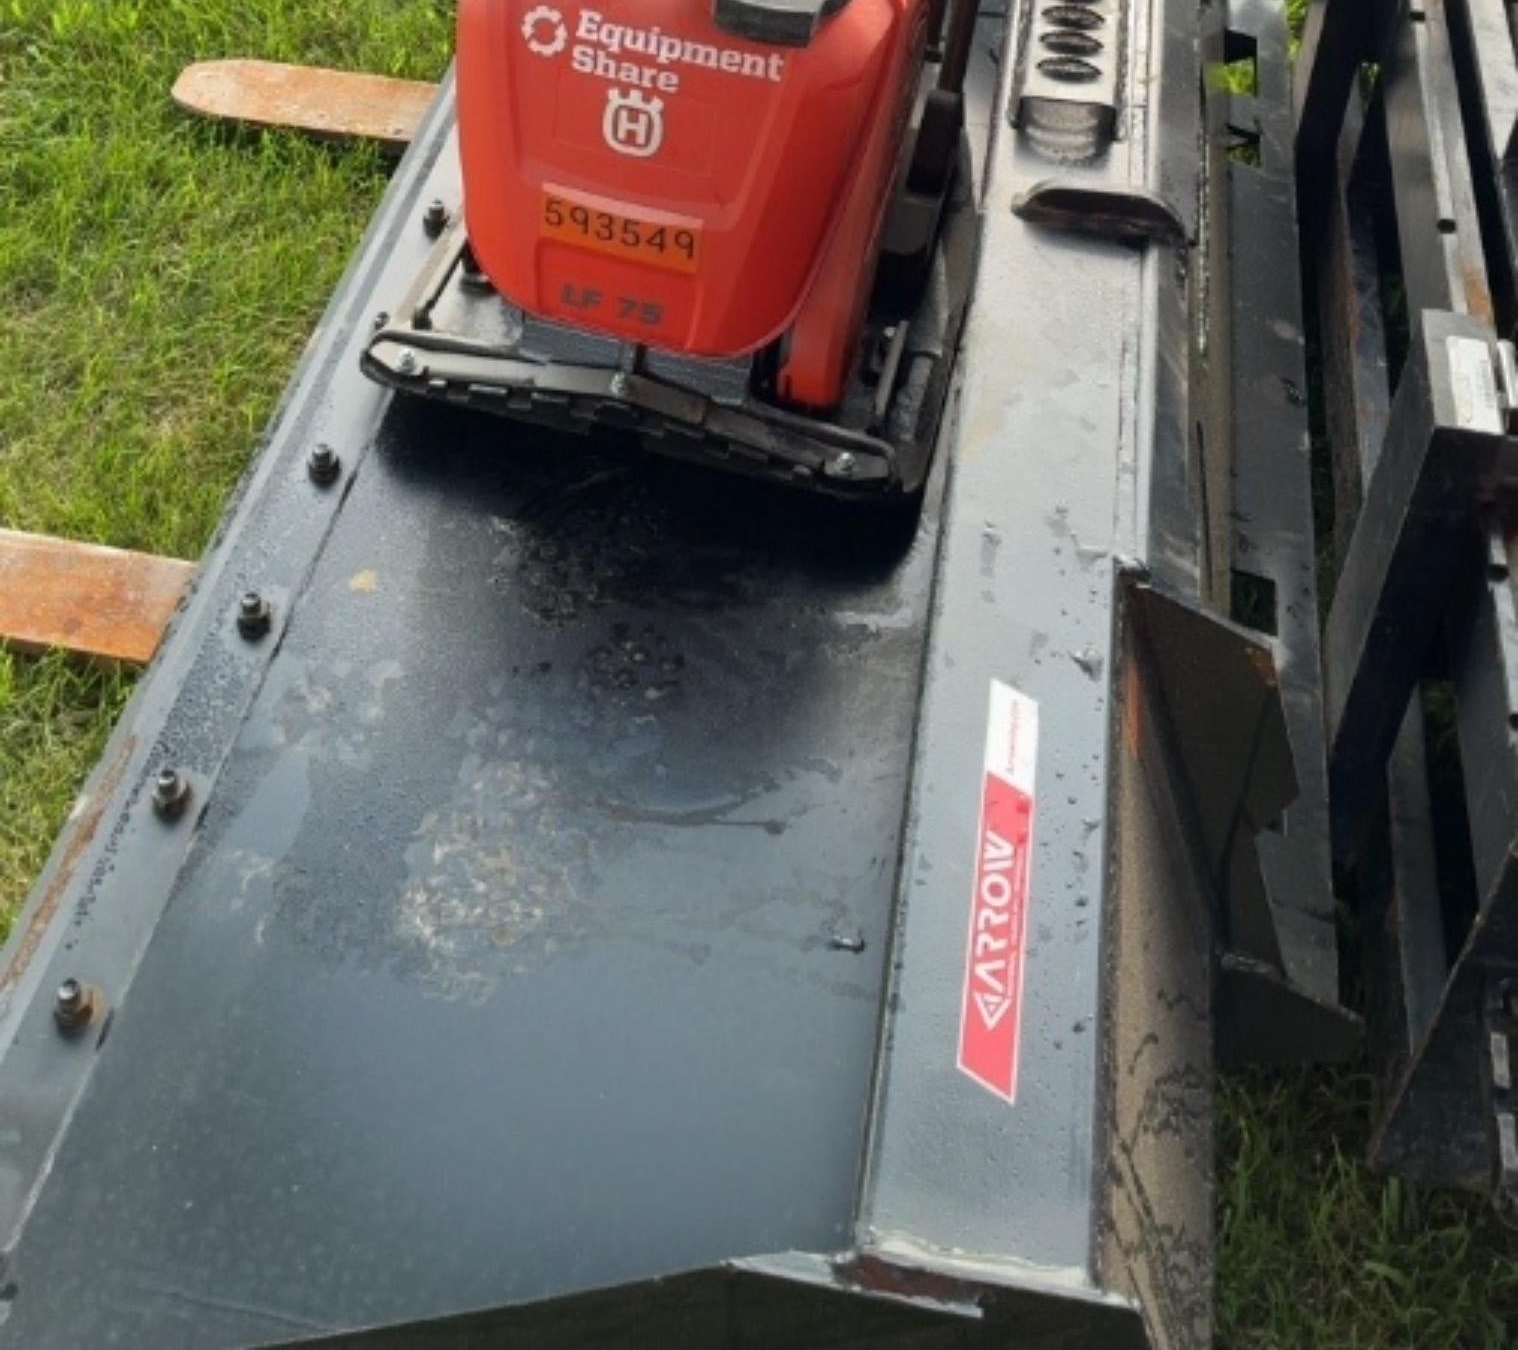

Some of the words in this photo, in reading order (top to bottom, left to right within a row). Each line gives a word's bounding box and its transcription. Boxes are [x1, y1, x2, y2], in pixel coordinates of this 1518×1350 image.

[571, 45, 680, 93] Share
[575, 9, 784, 82] Equipment
[544, 199, 695, 260] 593549
[560, 283, 602, 310] LF
[616, 297, 663, 325] 75
[974, 830, 1015, 996] ARROW
